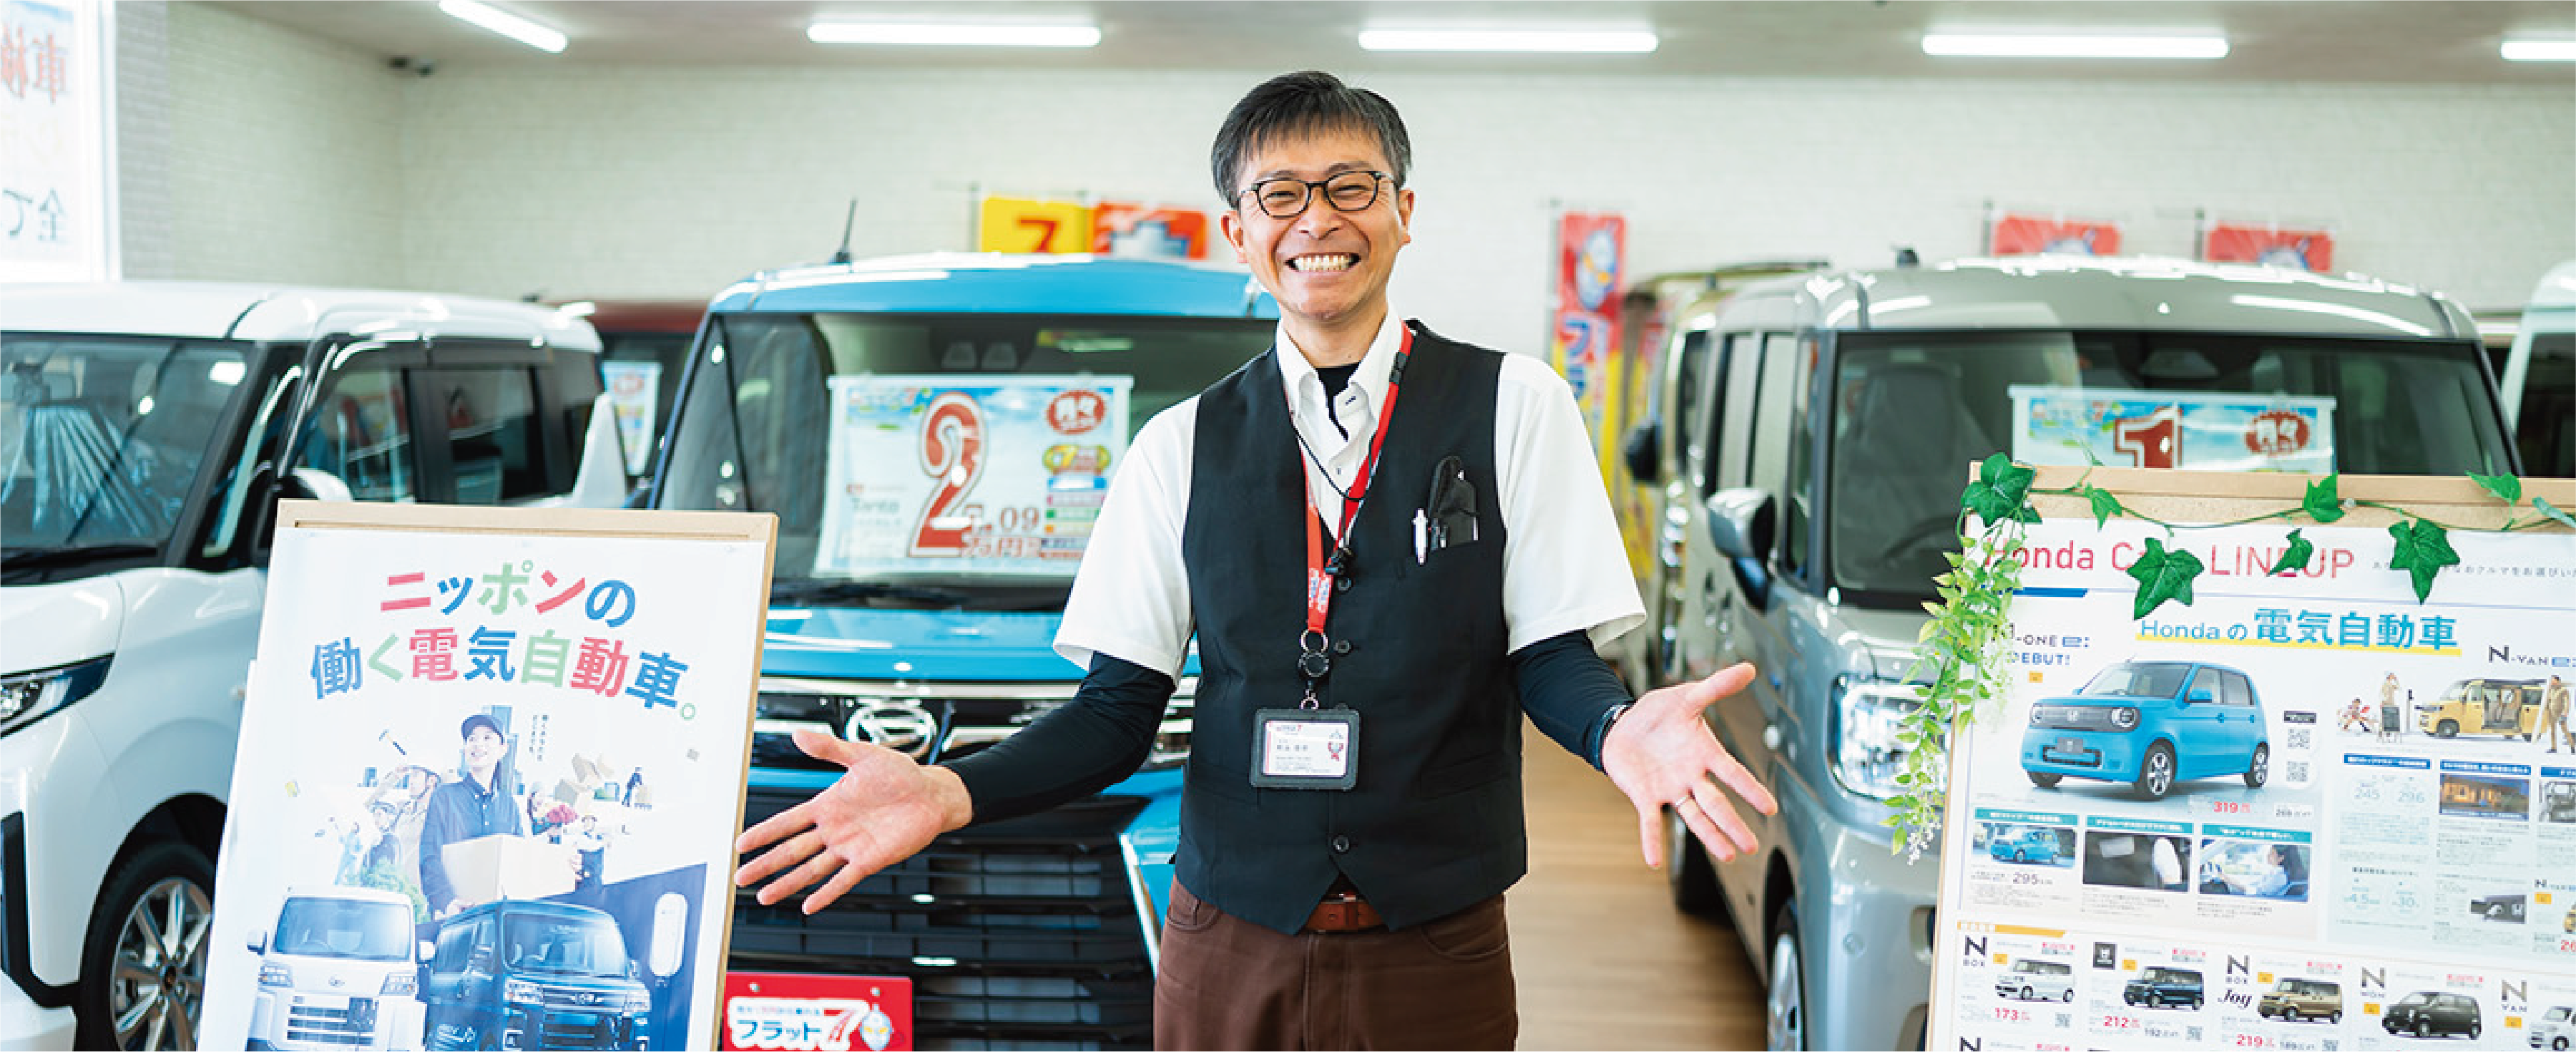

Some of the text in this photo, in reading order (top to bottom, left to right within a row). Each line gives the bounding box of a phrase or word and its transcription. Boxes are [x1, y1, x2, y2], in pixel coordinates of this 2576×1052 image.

[380, 560, 636, 628] ニッポンの
[310, 625, 696, 721] 働く電気自動車。
[2213, 802, 2239, 813] 319
[1964, 935, 1987, 957] N
[2227, 955, 2250, 975] N
[2361, 967, 2385, 988] N
[2217, 988, 2253, 1010] Joy
[2501, 979, 2527, 1002] N
[1994, 1007, 2019, 1021] 173
[2103, 1016, 2129, 1029] 212
[2236, 1034, 2263, 1047] 219
